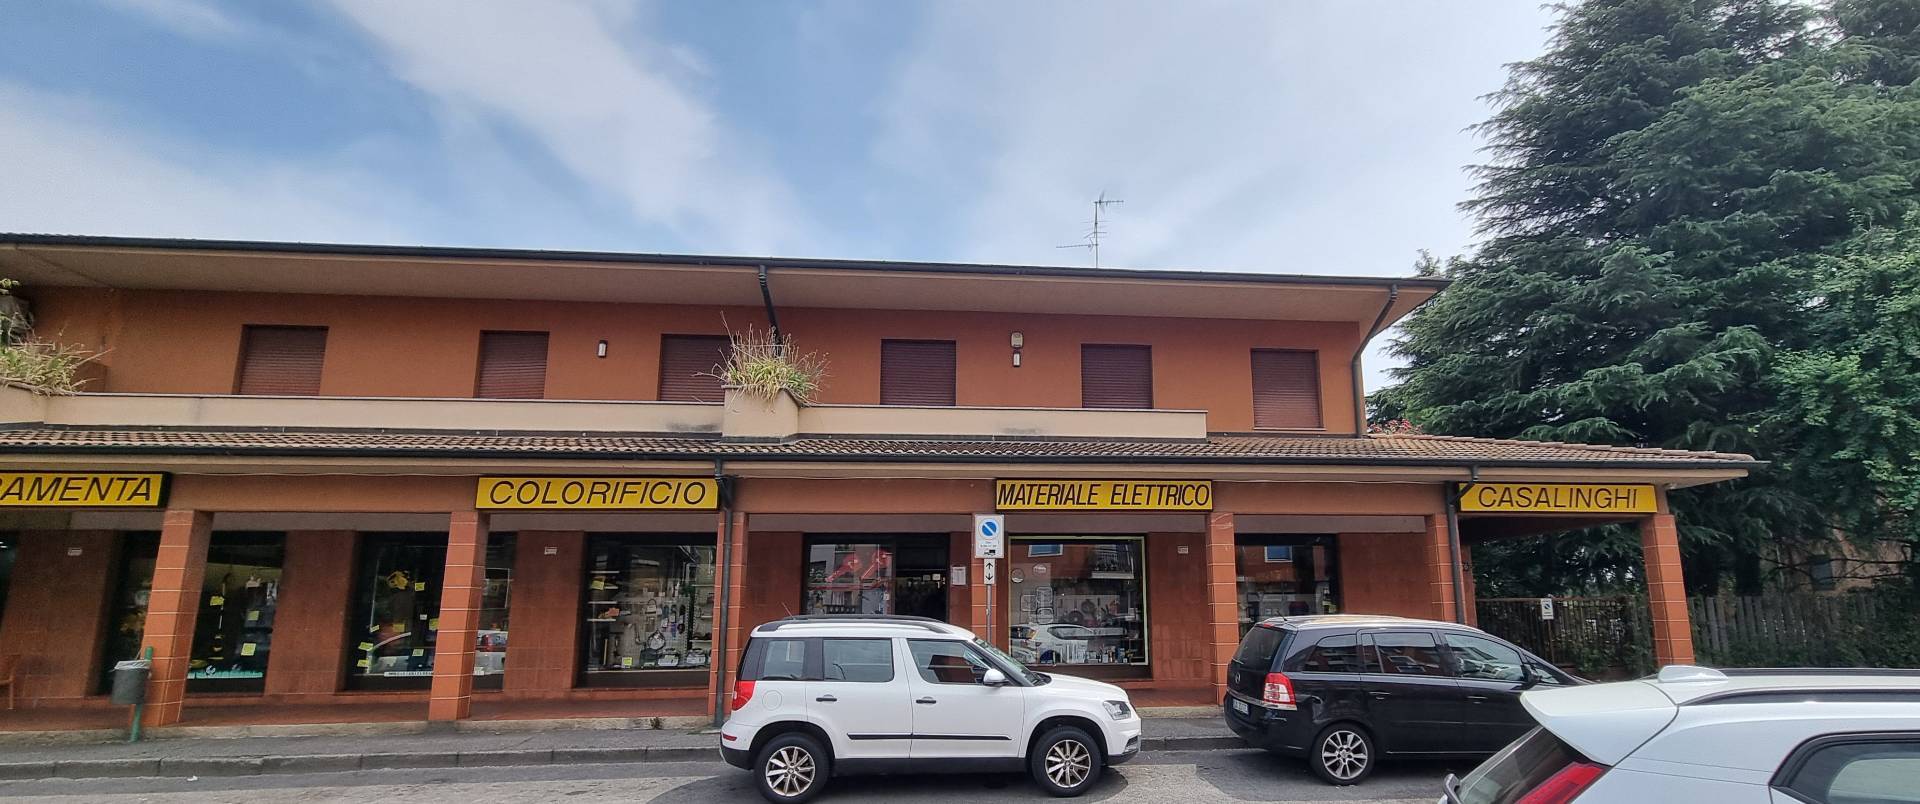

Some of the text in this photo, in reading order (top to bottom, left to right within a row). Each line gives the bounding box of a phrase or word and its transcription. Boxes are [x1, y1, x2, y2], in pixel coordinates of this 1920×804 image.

[0, 476, 152, 501] AMENTA
[489, 480, 706, 505] COLORIFICIO
[997, 483, 1210, 506] MATERIALE ELETTRICO
[1478, 486, 1637, 509] CASALINGHI
